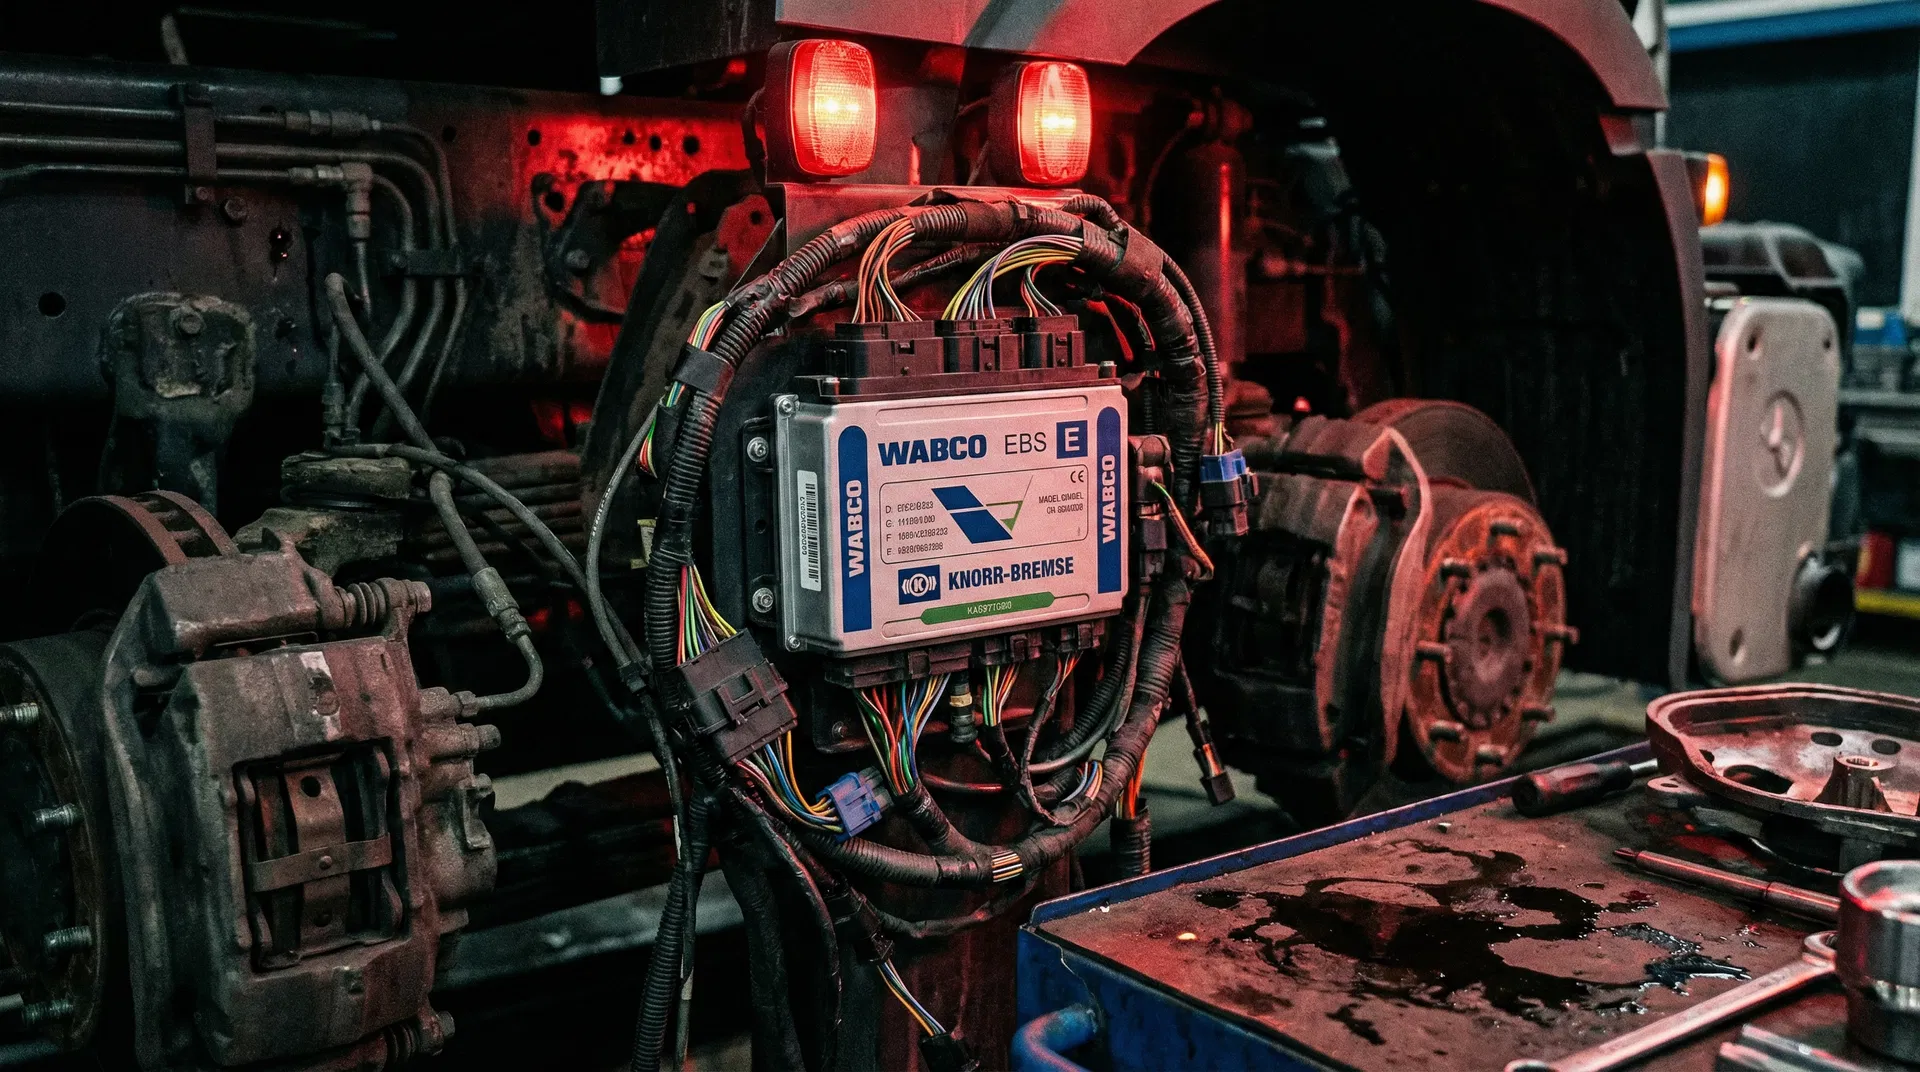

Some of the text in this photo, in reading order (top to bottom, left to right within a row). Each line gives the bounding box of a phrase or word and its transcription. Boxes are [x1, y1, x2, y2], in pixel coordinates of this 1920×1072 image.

[878, 435, 987, 466] WABCO
[1004, 432, 1047, 455] EBS
[846, 480, 864, 578] WABCO
[1101, 454, 1116, 544] WABCO
[949, 556, 1074, 591] KNORR-BREMSE
